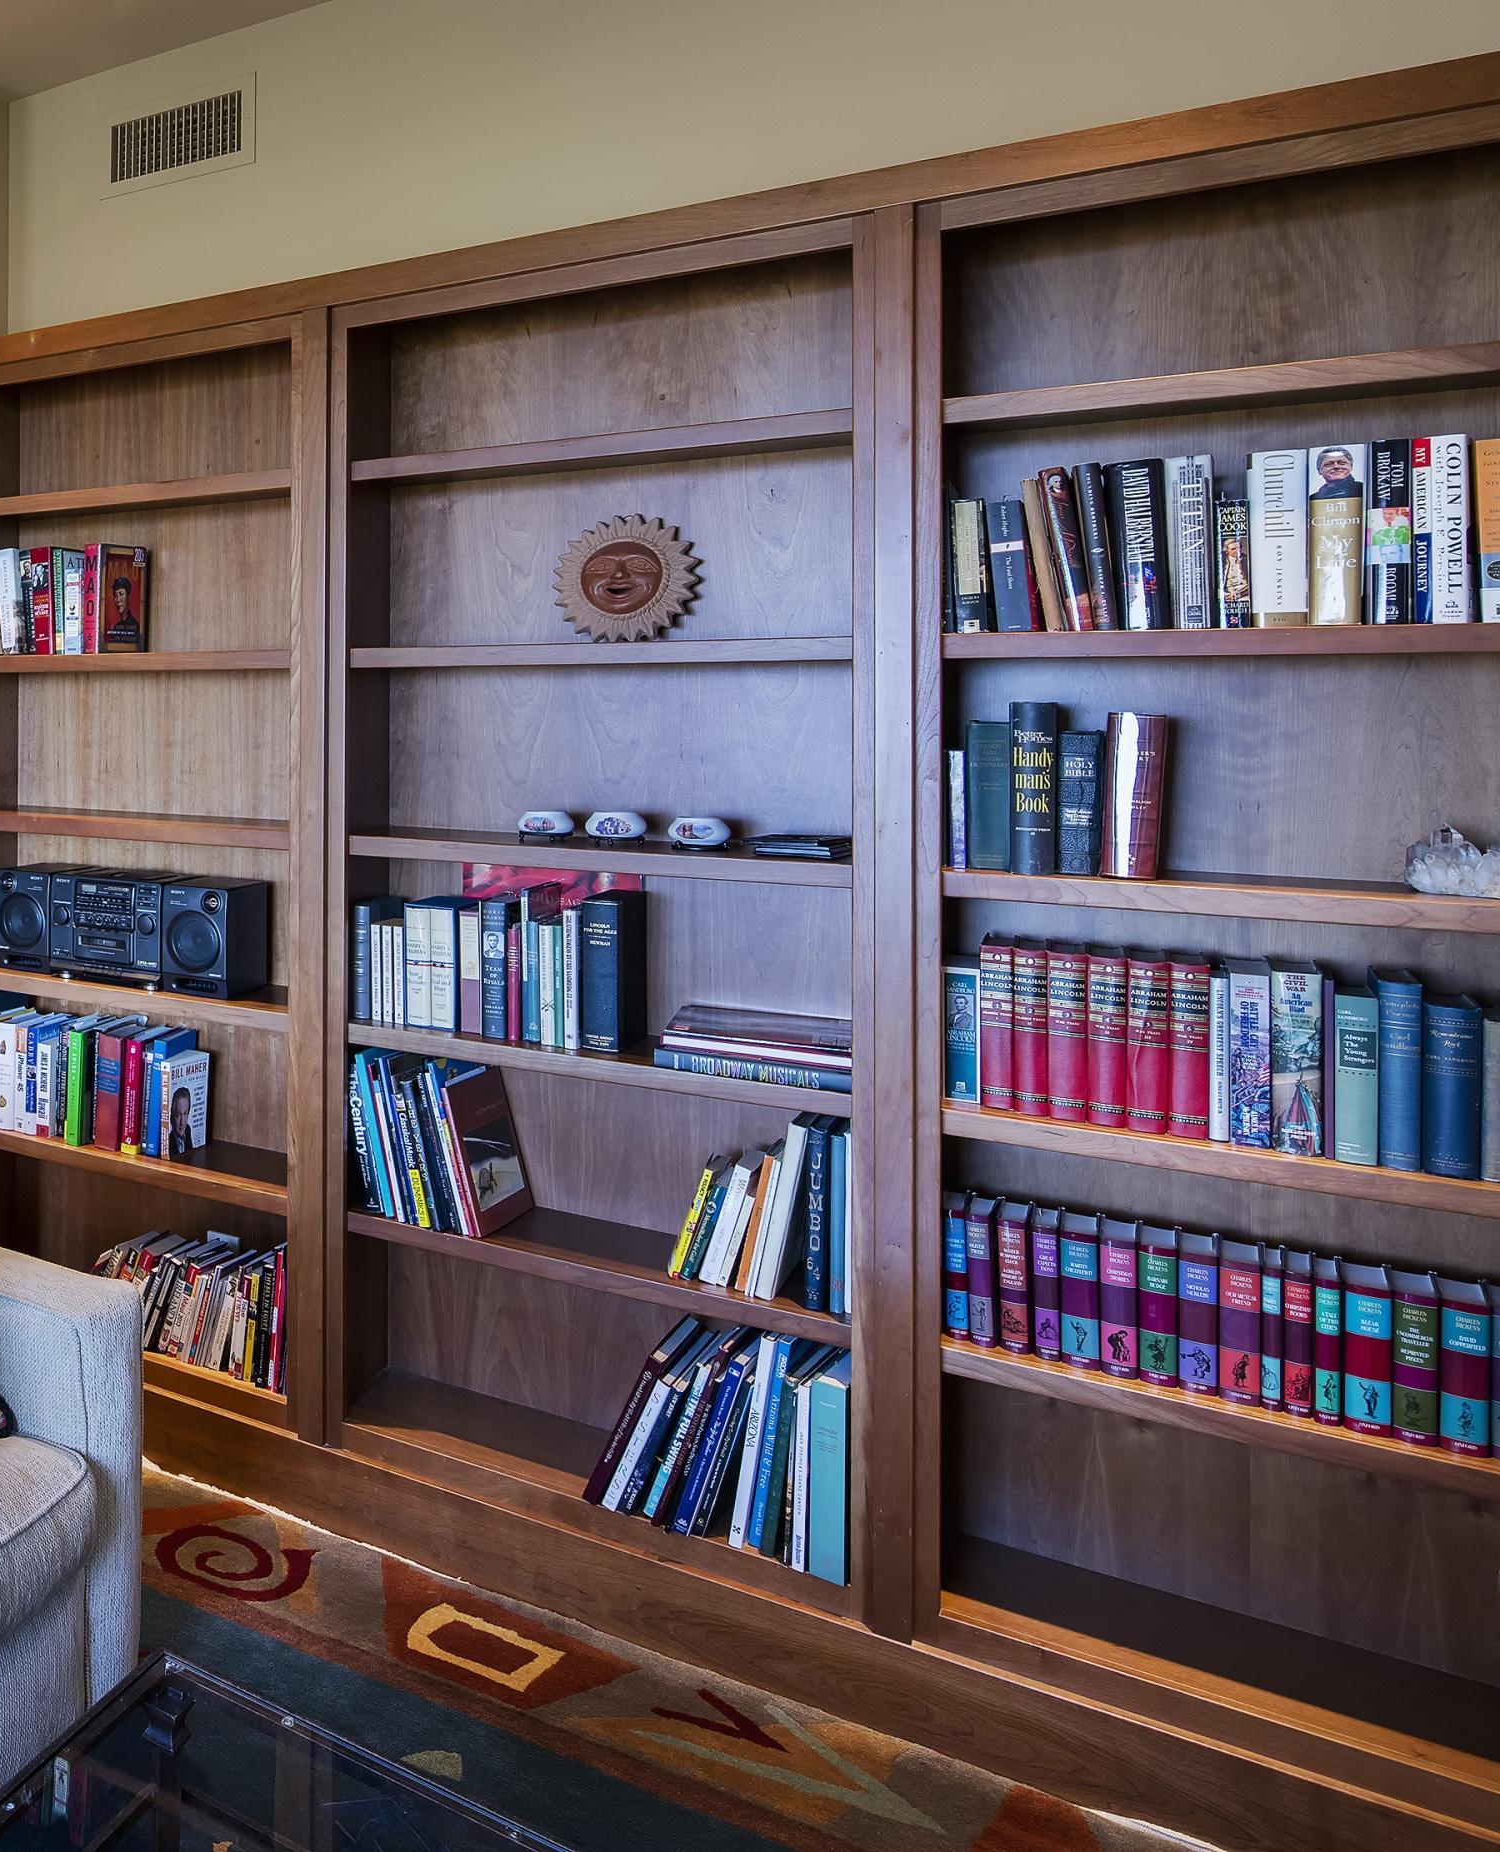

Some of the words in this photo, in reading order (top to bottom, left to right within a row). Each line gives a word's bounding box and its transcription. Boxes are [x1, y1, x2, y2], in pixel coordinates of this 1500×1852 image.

[1415, 447, 1427, 464] MY
[1435, 446, 1445, 474] with
[1377, 451, 1391, 501] BROKAW
[1391, 461, 1405, 488] TOM
[1445, 442, 1462, 506] COLIN
[1122, 467, 1150, 498] DAVID
[1263, 454, 1295, 539] Churchill
[1416, 470, 1427, 530] AMERICAN
[1434, 480, 1445, 523] Joseph
[1325, 501, 1347, 513] Bill
[1180, 478, 1205, 555] TITAN
[1311, 516, 1361, 528] Clinton
[1124, 498, 1155, 564] HALBERSTAM
[1219, 522, 1248, 532] COOK
[1320, 535, 1354, 551] My
[1315, 552, 1357, 569] Life
[1446, 516, 1463, 594] POWELL
[1416, 540, 1428, 593] JOURNEY
[85, 555, 97, 616] MAO
[1013, 729, 1045, 739] Better
[1018, 734, 1053, 743] Homes
[1065, 761, 1095, 769] HOLY
[1064, 769, 1095, 777] BIBLE
[1016, 792, 1050, 814] Book
[484, 964, 503, 972] TEAM
[980, 980, 1013, 989] LINCOLN
[1013, 977, 1047, 985] ABRAHAM
[1050, 981, 1086, 989] ABRAHAM
[1013, 985, 1047, 993] LINCOLN
[1050, 988, 1086, 998] LINCOLN
[1090, 985, 1126, 994] ABRAHAM
[1130, 989, 1167, 998] ABRAHAM
[1090, 993, 1126, 1002] LINCOLN
[1171, 993, 1209, 1001] ABRAHAM
[1291, 992, 1301, 1000] An
[1130, 997, 1167, 1007] LINCOLN
[1171, 1001, 1209, 1011] LINCOLN
[1240, 1001, 1249, 1011] OF
[1279, 999, 1313, 1007] American
[1379, 1000, 1421, 1010] Complete
[1289, 1005, 1305, 1013] Iliad
[1386, 1009, 1416, 1018] Poems
[1249, 1001, 1259, 1029] BATTLE
[1216, 1018, 1224, 1052] GREATEST
[1240, 1011, 1249, 1048] FREEDOM
[1249, 1030, 1259, 1049] CRY
[1343, 1033, 1368, 1042] Always
[1389, 1031, 1411, 1041] Carl
[1442, 1039, 1462, 1049] Rock
[1344, 1047, 1368, 1057] Young
[40, 1051, 48, 1066] JAMES
[1343, 1054, 1375, 1065] Strangers
[1216, 1053, 1224, 1077] SPEECH
[171, 1065, 184, 1080] BILL
[186, 1062, 207, 1076] MAHER
[691, 1055, 756, 1080] BROADWAY
[758, 1064, 820, 1089] MUSICALS
[17, 1082, 24, 1092] 4S
[40, 1071, 49, 1093] MICHENER
[38, 1097, 48, 1120] Hawaii
[399, 1112, 411, 1144] Classical
[405, 1143, 416, 1169] Music
[699, 1178, 708, 1196] NANCY
[809, 1152, 823, 1252] JUMBO
[1187, 1267, 1209, 1275] CHARLES
[1187, 1273, 1209, 1281] DICKENS
[1230, 1275, 1253, 1283] CHARLES
[1230, 1281, 1253, 1289] DICKENS
[168, 1280, 184, 1320] IRELAND
[1231, 1298, 1252, 1307] FRIEND
[1237, 1293, 1258, 1301] MUTUAL
[180, 1296, 189, 1314] Maui
[1357, 1300, 1382, 1309] CHARLES
[1358, 1306, 1382, 1315] DICKENS
[1402, 1307, 1428, 1316] CHARLES
[176, 1313, 184, 1327] 2013
[1360, 1319, 1380, 1327] BLEAK
[1402, 1313, 1428, 1323] DICKENS
[1455, 1315, 1481, 1325] CHARLES
[1360, 1325, 1380, 1334] HOUSE
[1455, 1322, 1481, 1332] DICKENS
[1396, 1329, 1435, 1342] UNCOMMERCIAL
[1458, 1335, 1477, 1343] DAVID
[1400, 1337, 1430, 1347] TRAVELLER
[1449, 1339, 1487, 1351] COPPERFIELD
[1400, 1348, 1430, 1359] REPRINTED
[1405, 1355, 1424, 1364] PIECES
[684, 1398, 700, 1419] THE
[767, 1395, 781, 1430] Arizona
[675, 1417, 693, 1442] FULL
[745, 1408, 761, 1448] ARIZONA
[610, 1392, 664, 1491] SISTERS
[764, 1434, 775, 1455] Wild
[660, 1440, 684, 1475] SWING
[759, 1468, 770, 1489] Free
[794, 1493, 804, 1516] CANYON
